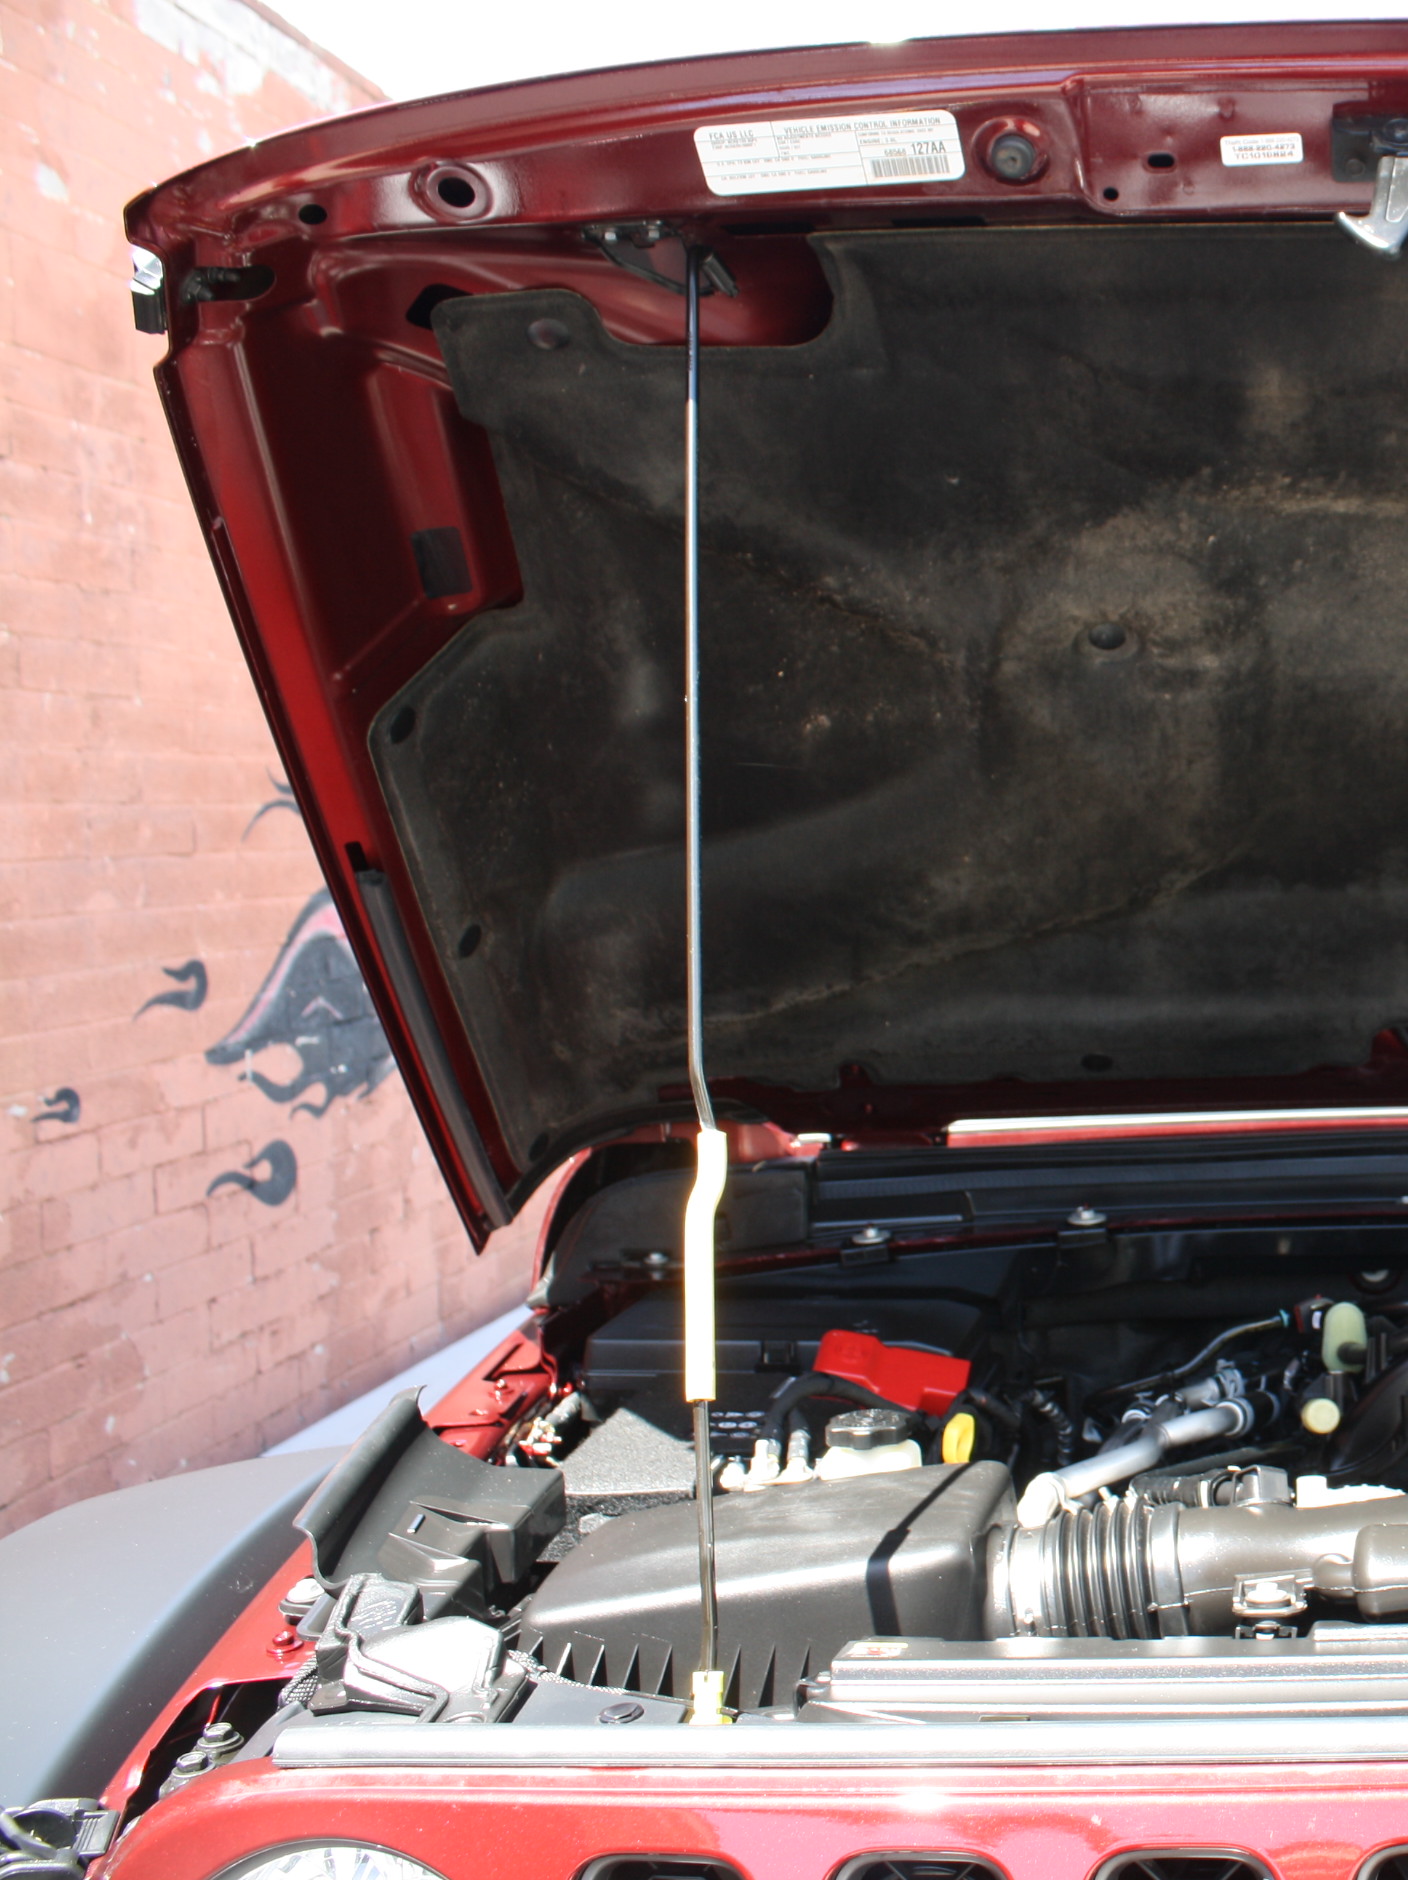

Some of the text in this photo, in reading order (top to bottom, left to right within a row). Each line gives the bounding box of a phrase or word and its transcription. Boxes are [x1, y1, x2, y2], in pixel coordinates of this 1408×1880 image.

[784, 126, 813, 135] VEHICLE
[816, 123, 852, 132] EMISSION
[854, 120, 887, 130] CONTROL
[890, 117, 941, 127] INFORMATION
[709, 129, 754, 140] FCA US LLC
[911, 140, 946, 155] 127AA
